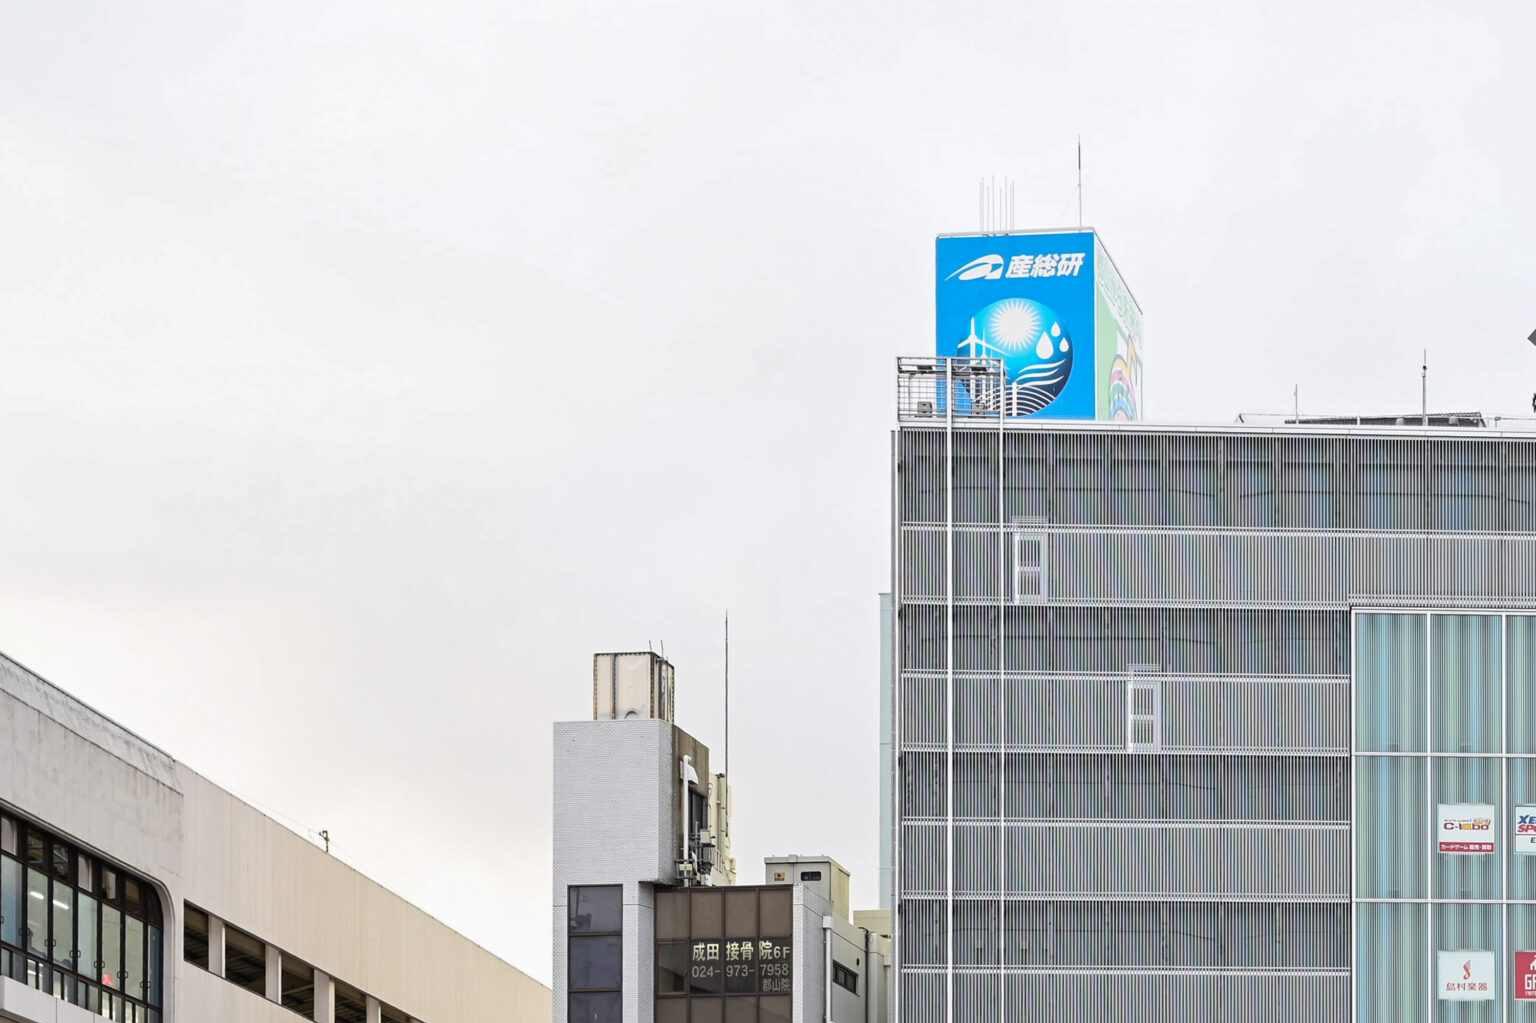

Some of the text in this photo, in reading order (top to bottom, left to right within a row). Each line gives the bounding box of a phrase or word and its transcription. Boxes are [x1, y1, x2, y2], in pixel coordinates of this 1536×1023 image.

[1005, 253, 1086, 278] 産総研
[762, 978, 791, 992] 郡山院
